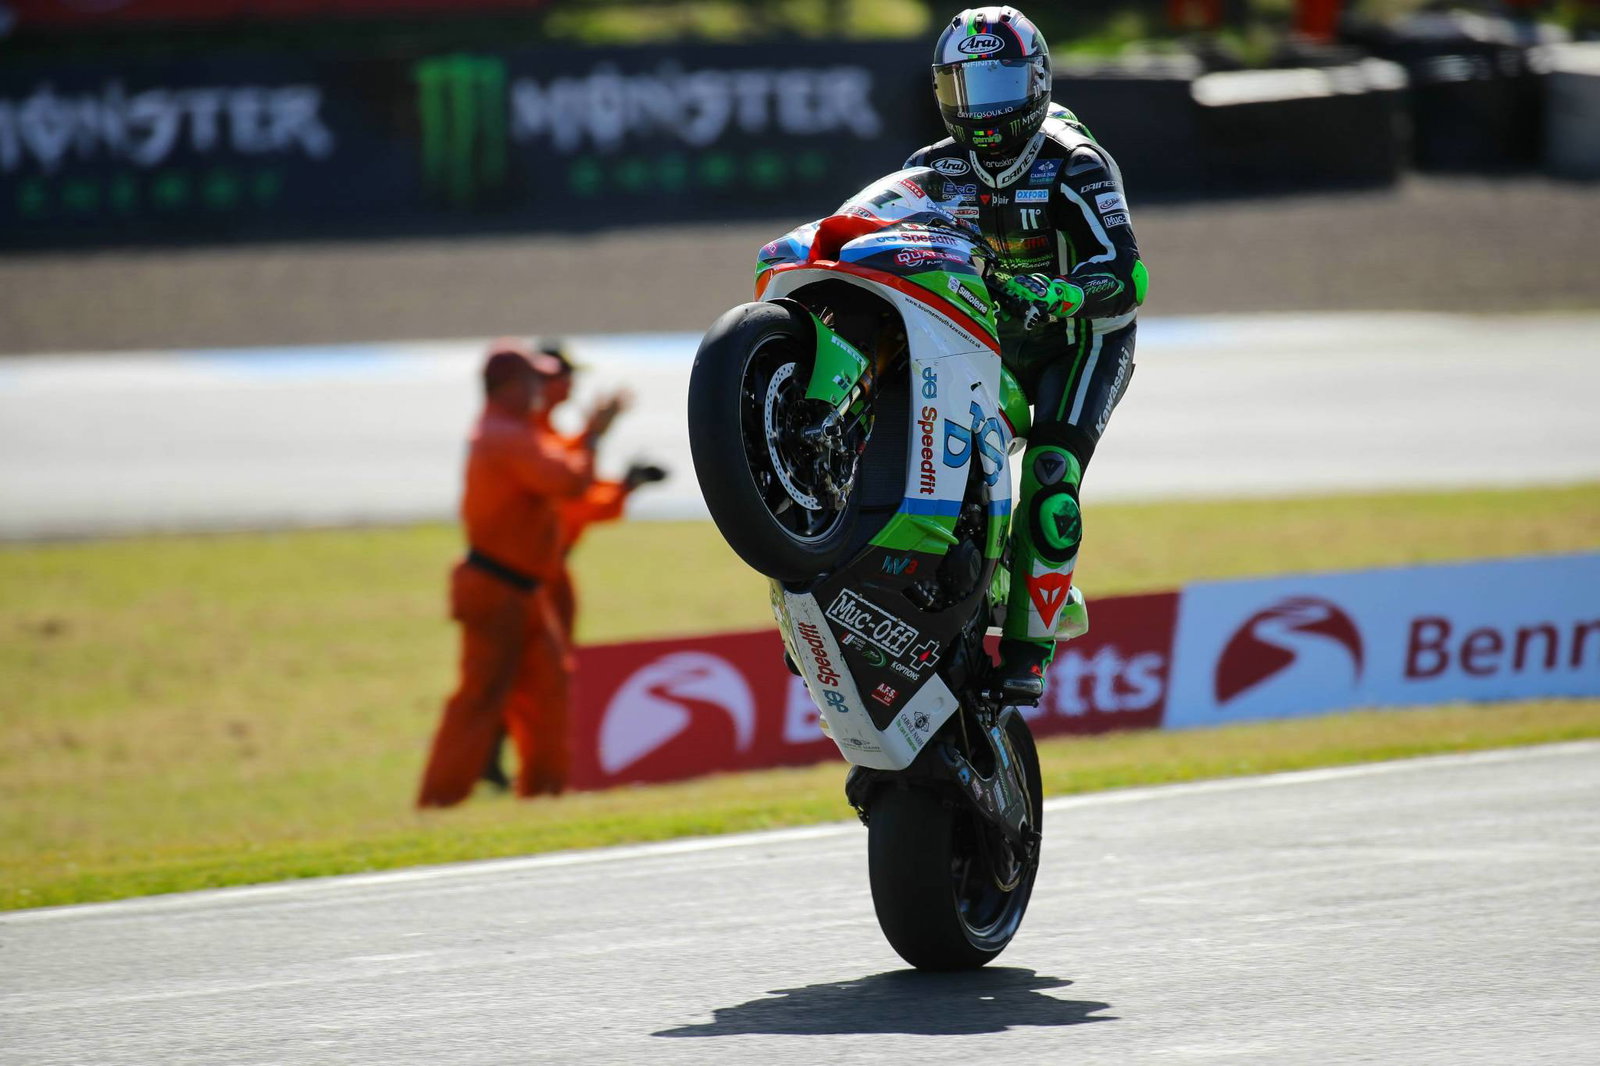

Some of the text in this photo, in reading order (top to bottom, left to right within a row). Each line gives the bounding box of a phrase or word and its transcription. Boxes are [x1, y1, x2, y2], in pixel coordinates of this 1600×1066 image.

[961, 37, 997, 50] Arai
[935, 160, 965, 171] Arai
[1002, 140, 1039, 184] DAINESE
[1017, 190, 1047, 199] OXFORD
[901, 233, 958, 246] Speedfit
[958, 286, 988, 314] Silkolene
[1095, 347, 1130, 435] Kawasaki
[917, 405, 938, 495] Speedfit
[797, 621, 841, 687] Speedfit
